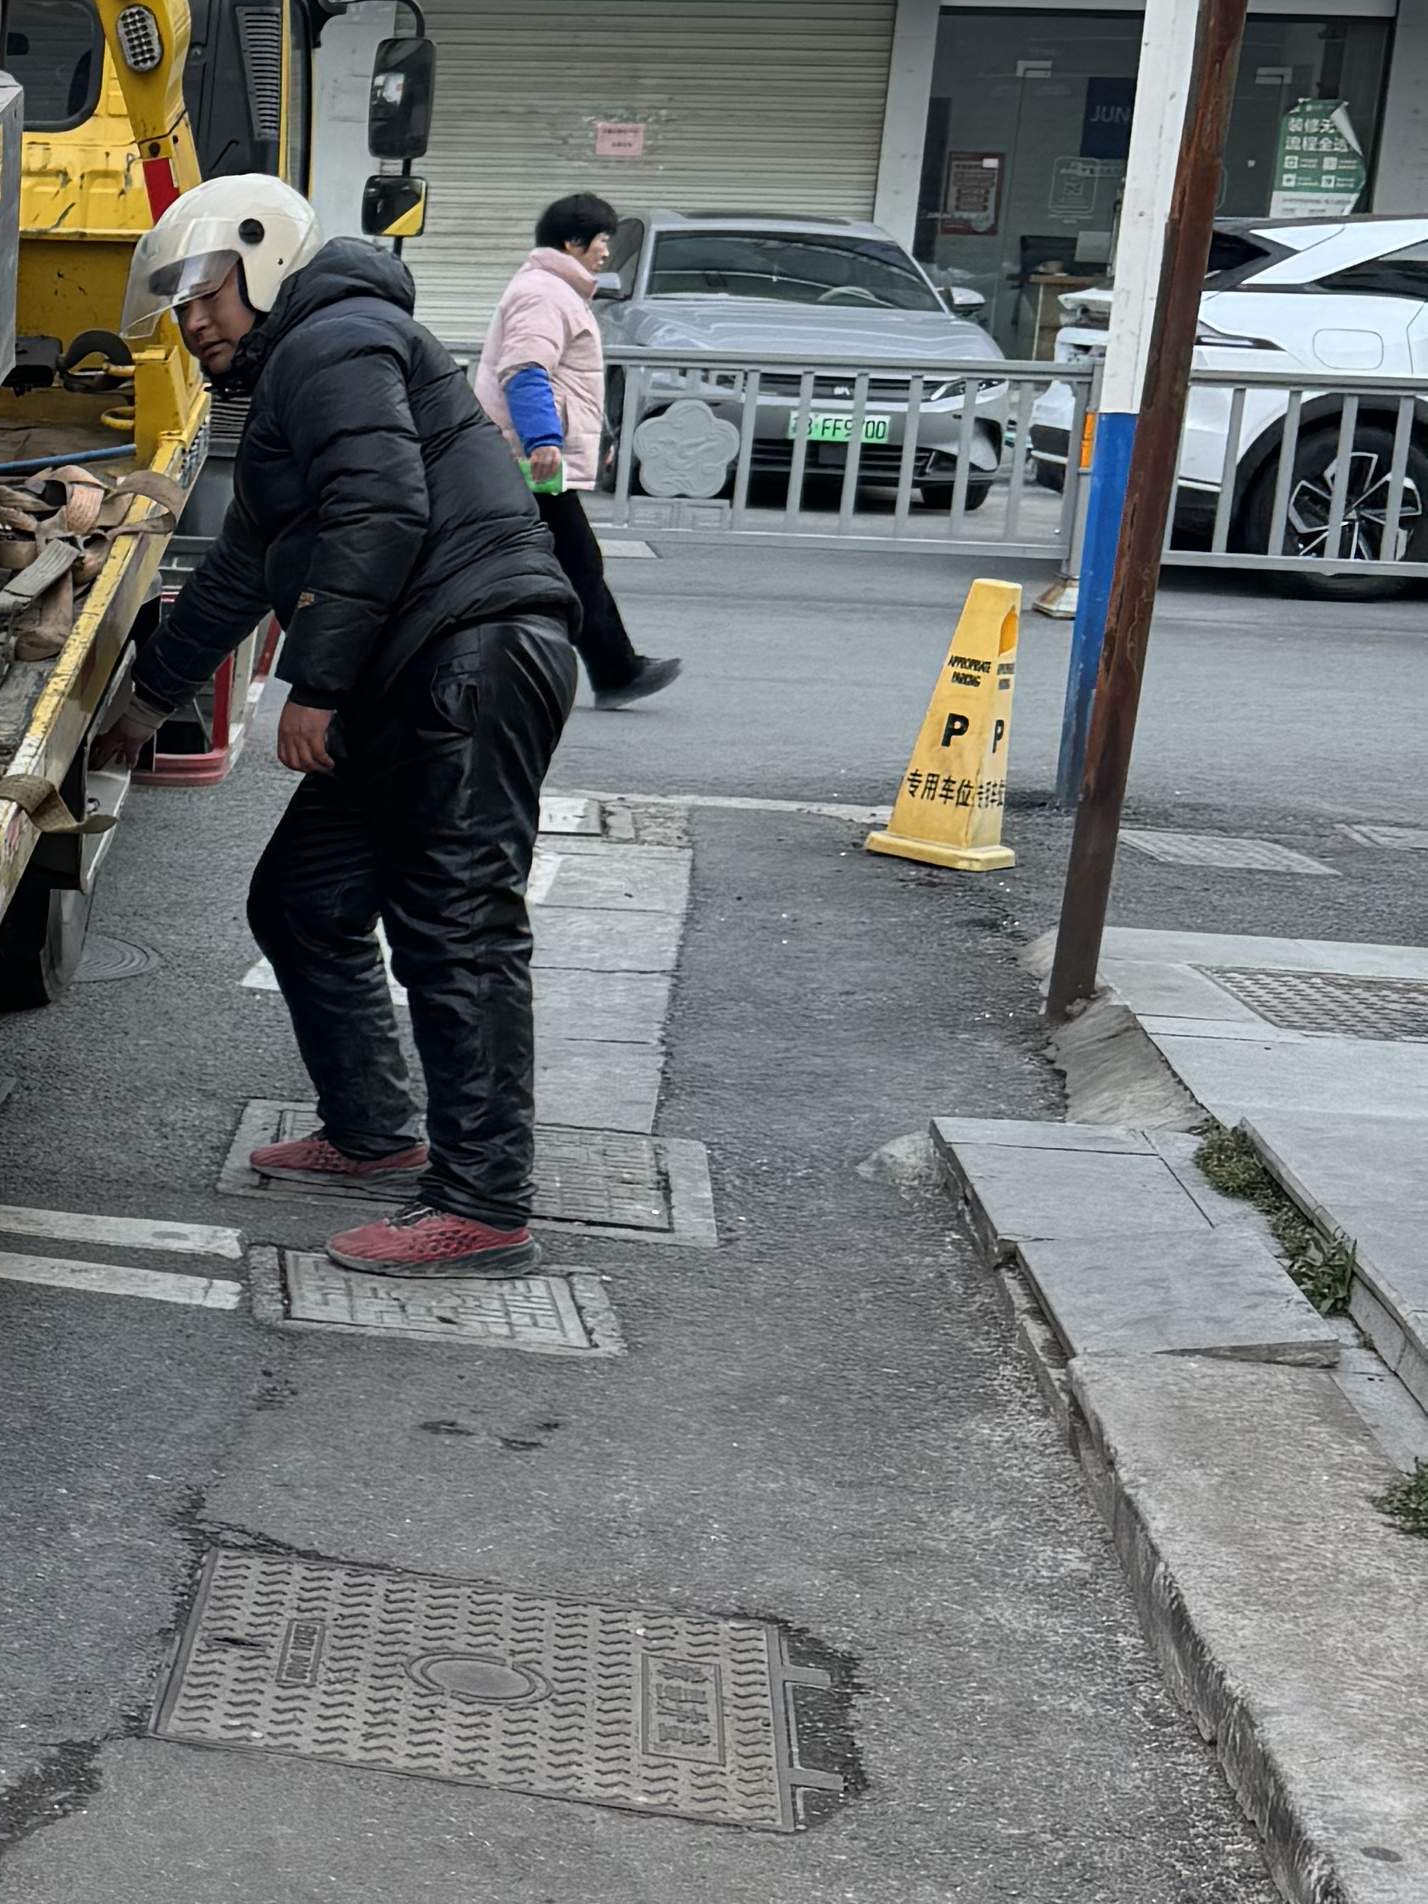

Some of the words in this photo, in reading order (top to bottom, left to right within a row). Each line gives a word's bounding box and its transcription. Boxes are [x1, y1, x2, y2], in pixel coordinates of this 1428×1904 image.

[941, 713, 970, 747] P
[907, 768, 974, 807] 专用车位
